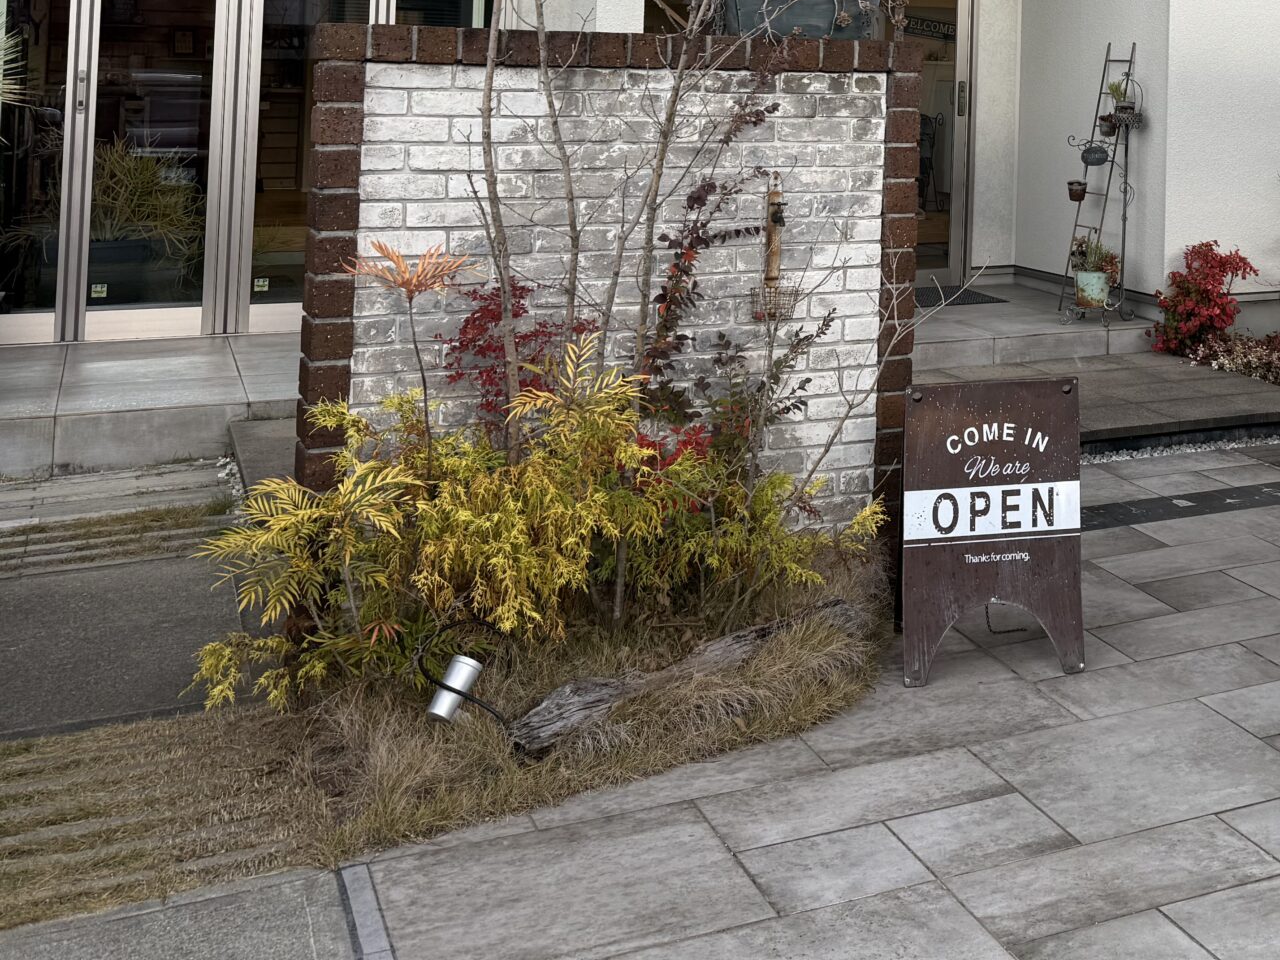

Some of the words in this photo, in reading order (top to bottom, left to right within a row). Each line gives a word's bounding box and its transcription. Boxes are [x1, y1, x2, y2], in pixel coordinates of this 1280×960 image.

[906, 17, 955, 35] ELCOME
[946, 422, 1016, 454] COME
[1024, 427, 1049, 453] IN
[964, 455, 1000, 480] We
[1002, 460, 1030, 475] are
[932, 486, 1054, 535] OPEN
[964, 553, 990, 564] Thanks
[991, 551, 1001, 562] for
[1001, 550, 1030, 562] coming.
